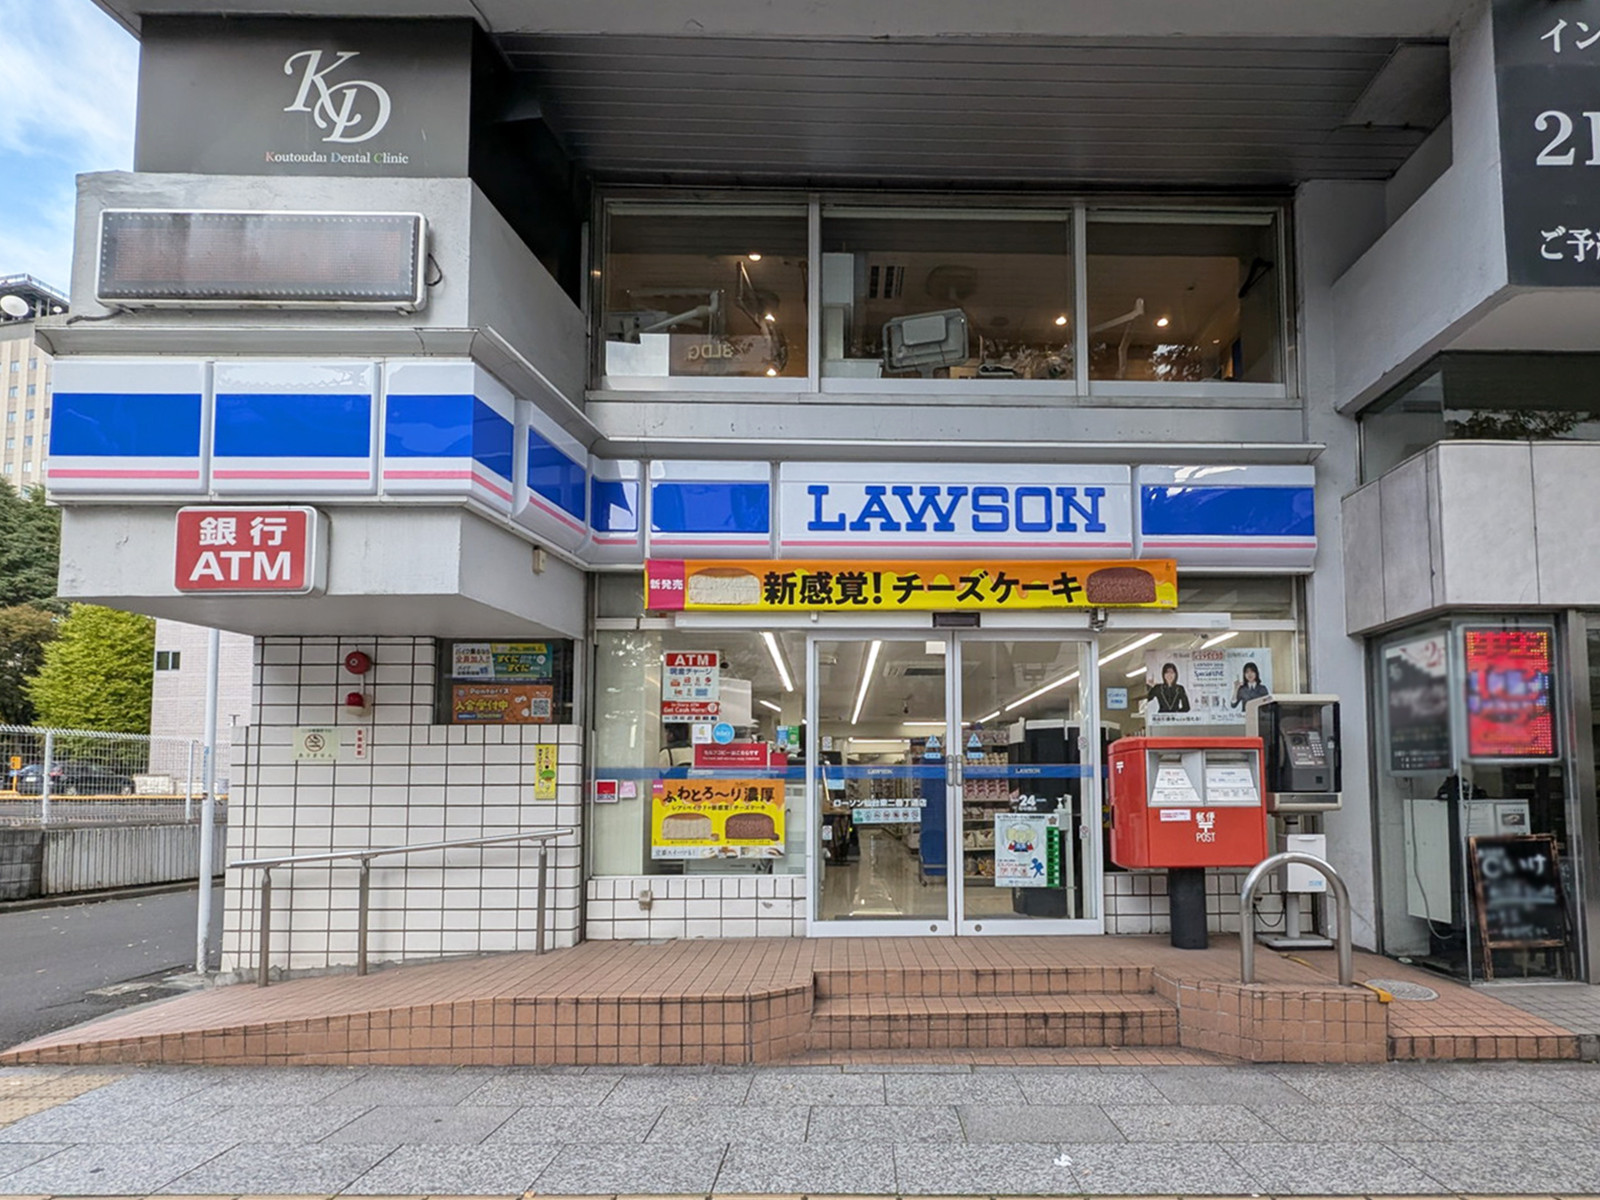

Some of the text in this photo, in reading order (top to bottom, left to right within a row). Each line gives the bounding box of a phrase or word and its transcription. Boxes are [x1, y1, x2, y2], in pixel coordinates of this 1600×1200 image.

[265, 152, 409, 164] Koutoudai Dental Clinic
[1540, 225, 1600, 262] ご予
[807, 484, 1106, 532] LAWSON
[198, 516, 288, 546] 銀行
[189, 551, 291, 581] ATM
[650, 579, 683, 590] 新発売
[763, 570, 1082, 605] 新感覚!チーズケーキ
[674, 654, 709, 666] ATM
[1019, 794, 1037, 807] 24
[1196, 832, 1215, 842] POST
